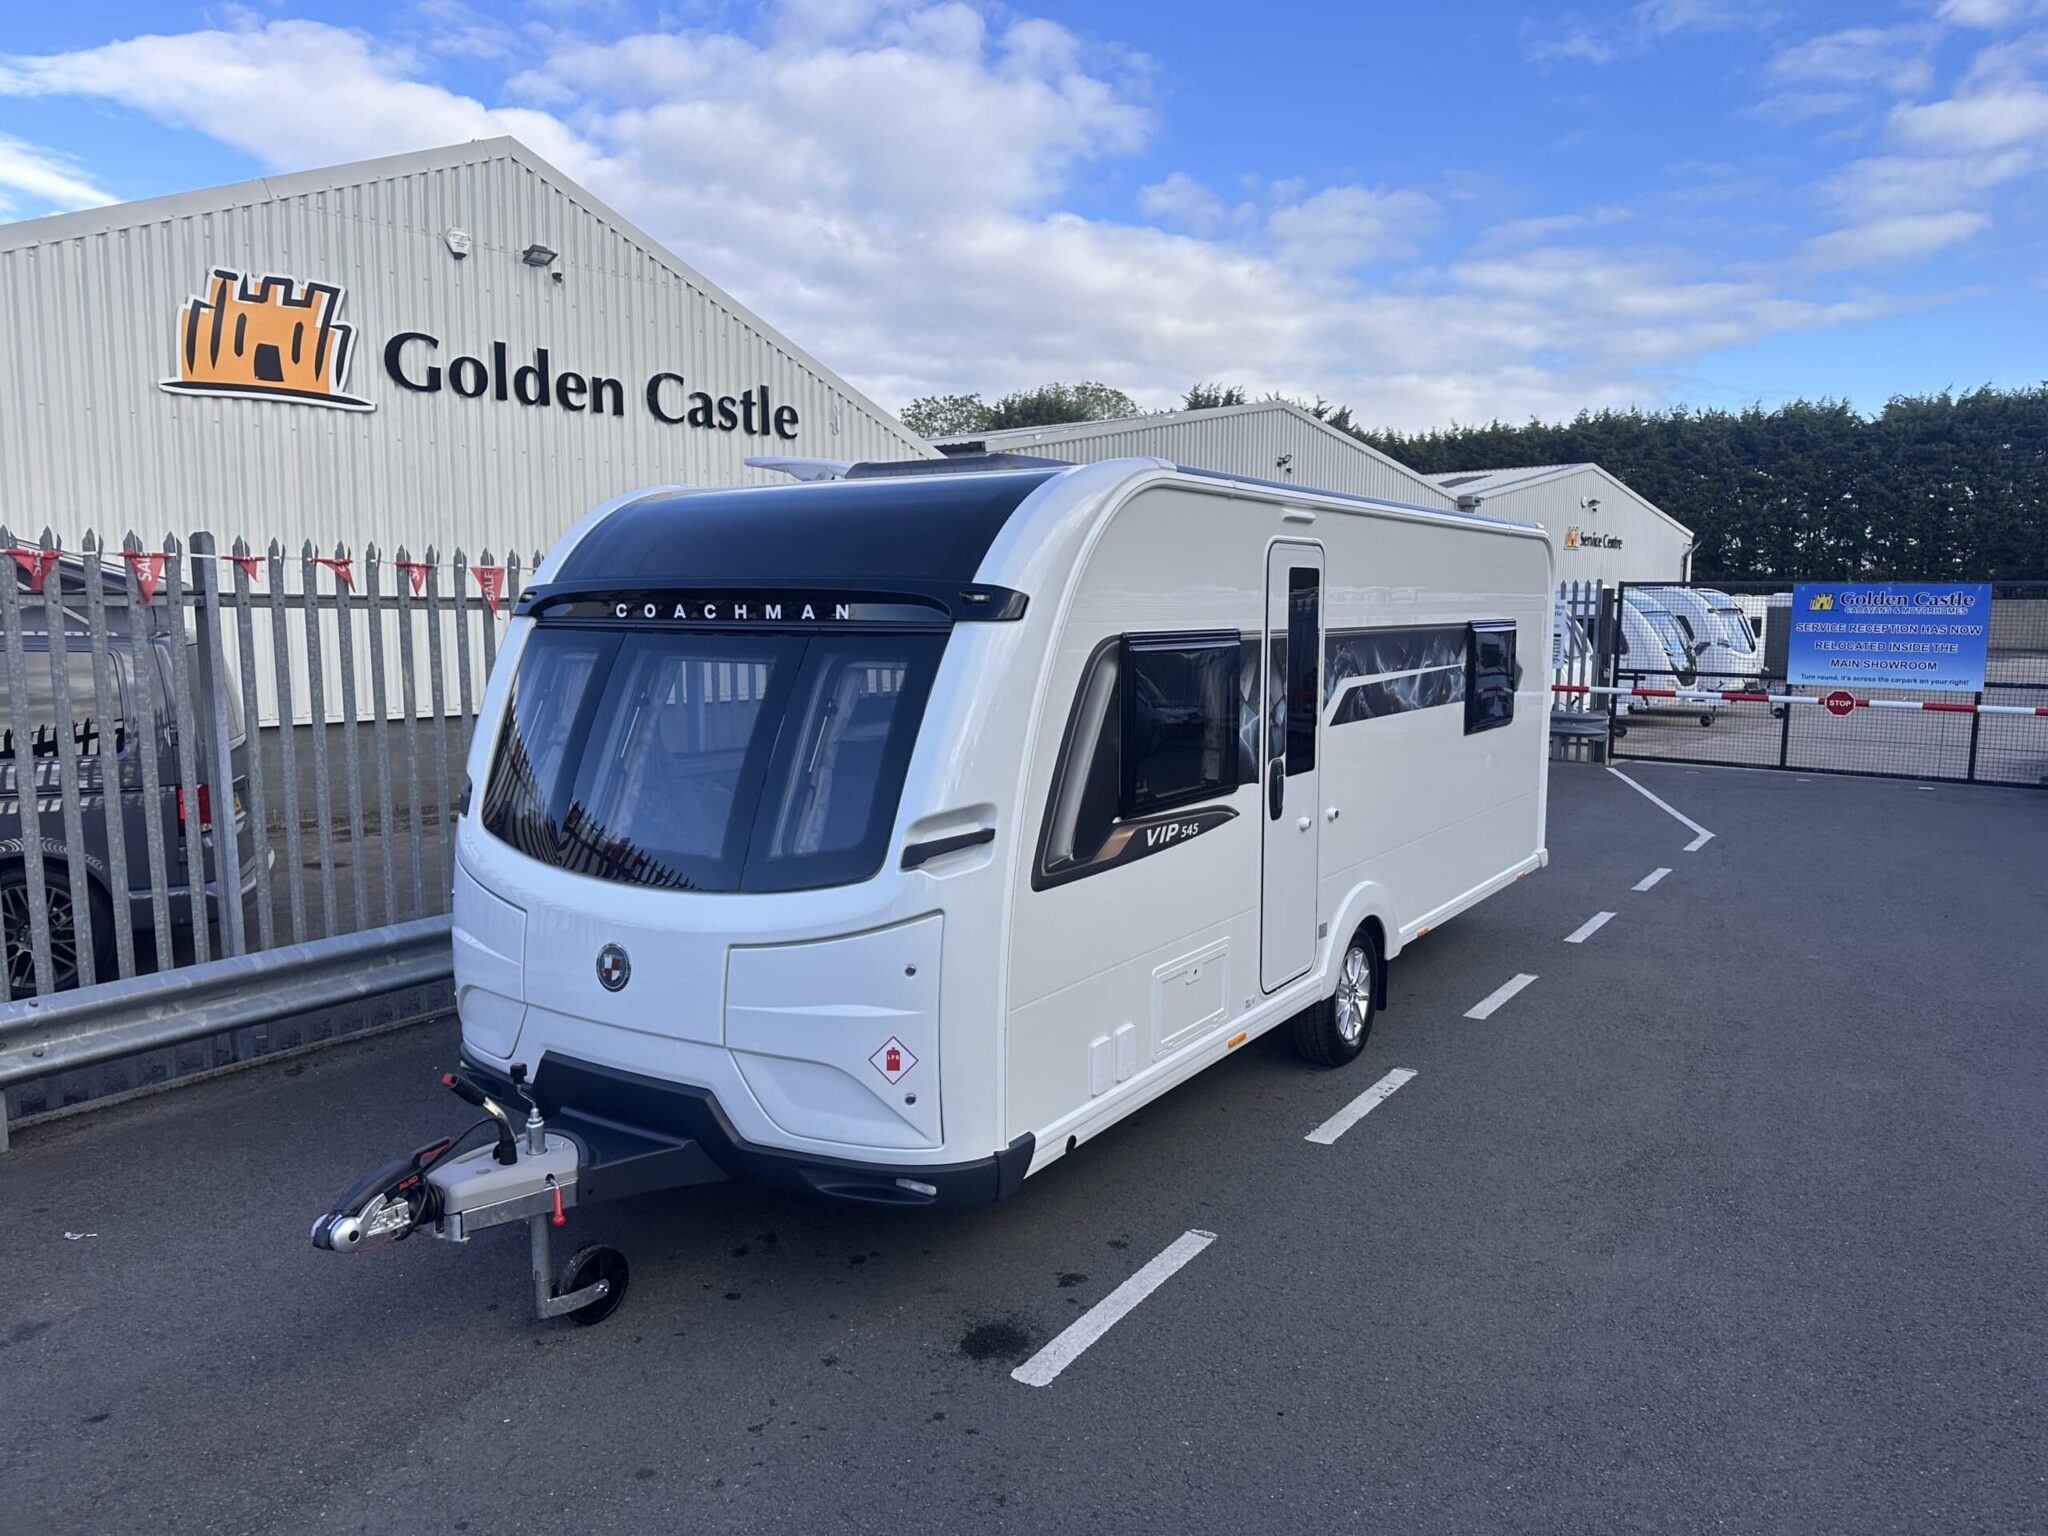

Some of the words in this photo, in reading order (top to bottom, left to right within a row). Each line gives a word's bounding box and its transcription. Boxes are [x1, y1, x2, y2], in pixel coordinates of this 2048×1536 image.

[384, 331, 624, 416] Golden
[646, 372, 800, 439] Castle
[1580, 531, 1602, 548] Service
[1603, 534, 1623, 549] Centre
[484, 571, 496, 601] SALE
[1839, 591, 1909, 607] Golden
[1914, 592, 1975, 607] Castle
[615, 603, 851, 621] COACHMAN
[1844, 606, 1892, 614] CARAVANS
[1893, 607, 1900, 615] &
[1901, 607, 1968, 615] MOTORHOMES
[1796, 623, 1845, 633] SERVICE
[1848, 624, 1918, 634] RECEPTION
[1921, 625, 1948, 634] HAS
[1950, 625, 1982, 635] NOW
[1815, 641, 1886, 652] RELOCATED
[1889, 643, 1929, 653] INSIDE
[1932, 643, 1958, 653] THE
[1830, 659, 1860, 669] MAIN
[1863, 660, 1937, 671] SHOWROOM
[1891, 677, 1918, 685] carpark
[1146, 823, 1179, 847] VIP
[1181, 822, 1199, 838] 545
